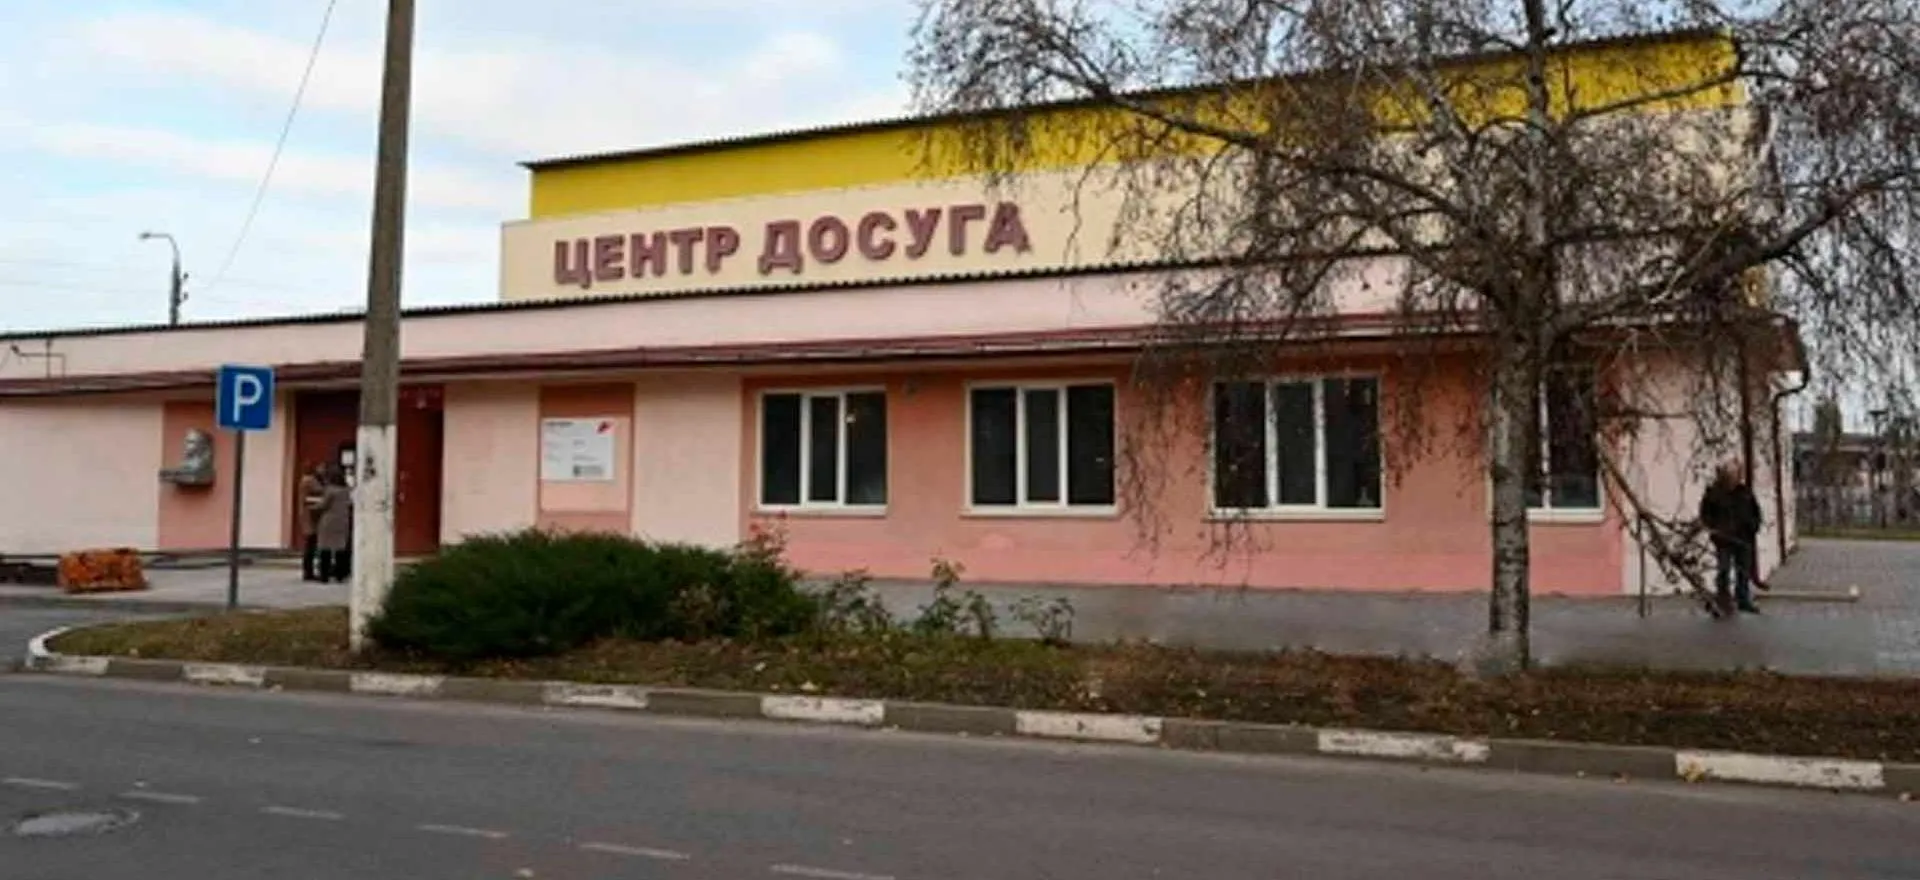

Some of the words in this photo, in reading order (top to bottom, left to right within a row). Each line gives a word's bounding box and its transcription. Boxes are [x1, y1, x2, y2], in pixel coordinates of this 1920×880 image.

[554, 226, 740, 290] ЦЕНТР
[758, 201, 1031, 276] ДОСУГА
[232, 373, 264, 422] P
